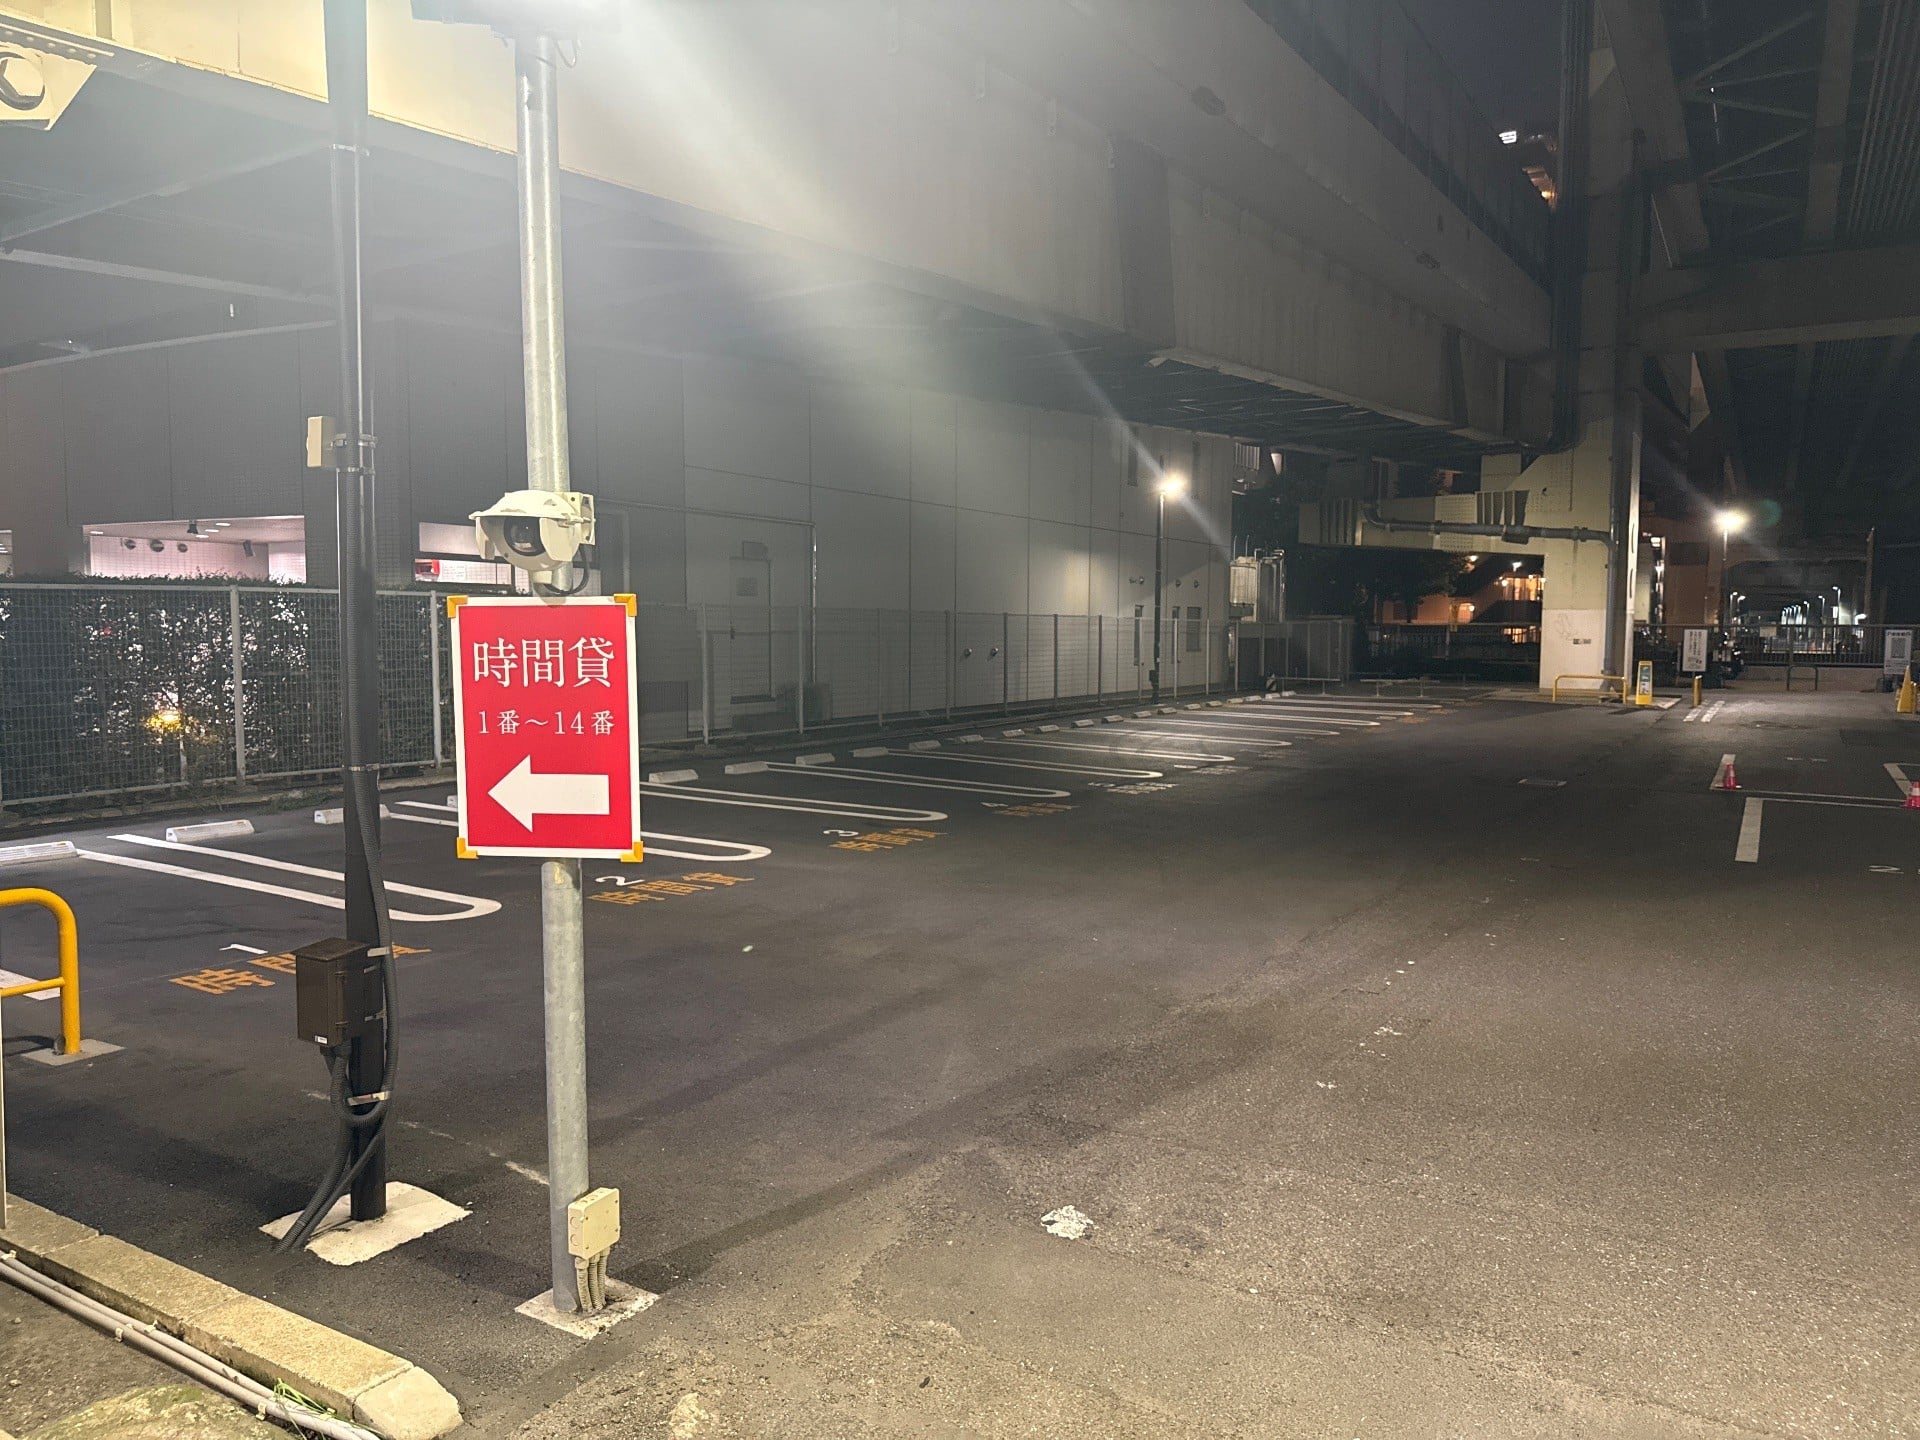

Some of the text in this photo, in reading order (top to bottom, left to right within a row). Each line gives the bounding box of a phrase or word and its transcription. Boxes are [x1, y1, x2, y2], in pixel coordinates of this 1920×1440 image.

[472, 636, 614, 688] 時間貸
[823, 829, 859, 837] 3
[594, 875, 646, 887] 2
[219, 943, 269, 955] 1
